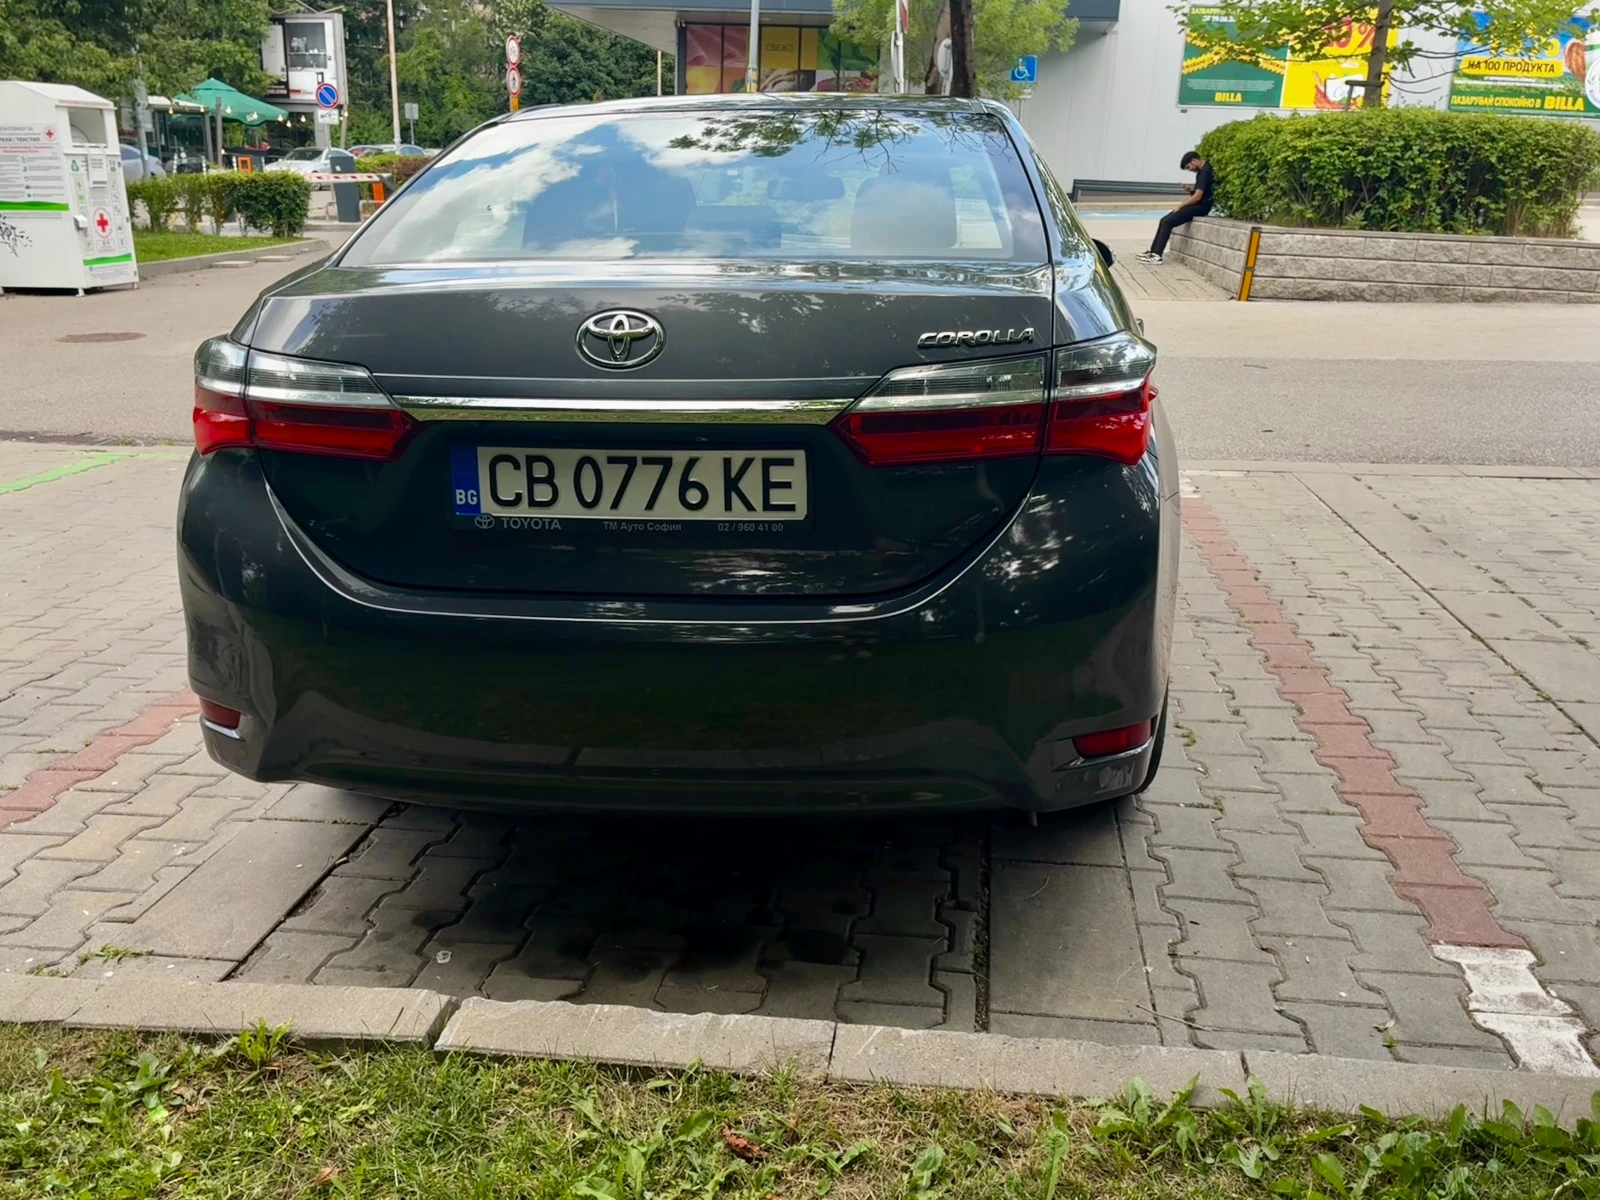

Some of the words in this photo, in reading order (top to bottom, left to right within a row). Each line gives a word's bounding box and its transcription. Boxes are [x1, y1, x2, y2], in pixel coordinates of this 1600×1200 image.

[1467, 60, 1481, 70] НА
[1485, 60, 1500, 71] 100
[1502, 61, 1555, 73] ПРОДУКТА
[1214, 92, 1242, 102] BILLA
[1451, 95, 1494, 106] ПАЗАРУВАЙ
[1494, 96, 1534, 108] СПОКОЙНО
[1544, 96, 1584, 111] BILLA
[917, 327, 1034, 347] COROLLA
[489, 454, 559, 508] CB
[573, 455, 709, 511] 0776
[723, 457, 796, 512] KE
[455, 489, 478, 505] BG
[501, 518, 562, 530] TOYOTA
[620, 521, 645, 533] Ауто
[647, 522, 682, 532] София
[718, 523, 729, 532] 02
[738, 523, 755, 532] 960
[758, 523, 769, 532] 41
[772, 523, 783, 532] 00
